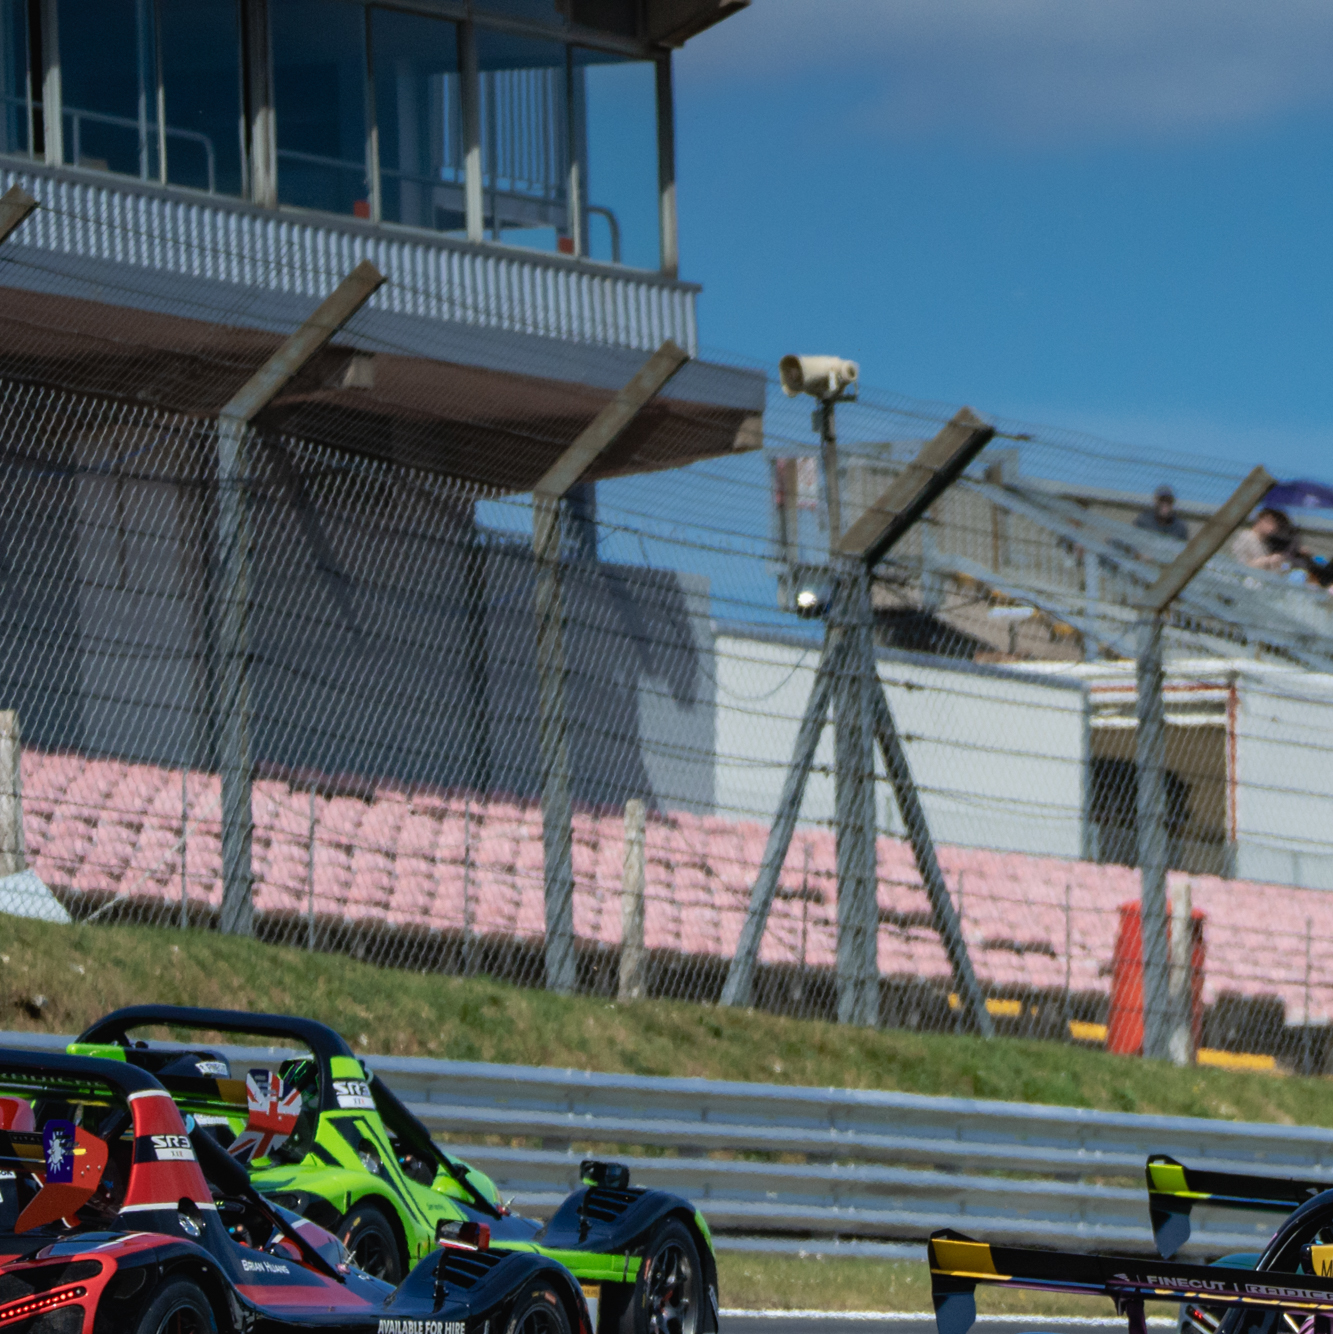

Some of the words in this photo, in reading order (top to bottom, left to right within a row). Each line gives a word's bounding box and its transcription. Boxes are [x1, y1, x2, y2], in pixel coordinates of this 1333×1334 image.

[332, 1081, 371, 1096] SR3
[151, 1135, 191, 1149] SR3
[1147, 1275, 1226, 1292] FINECUT
